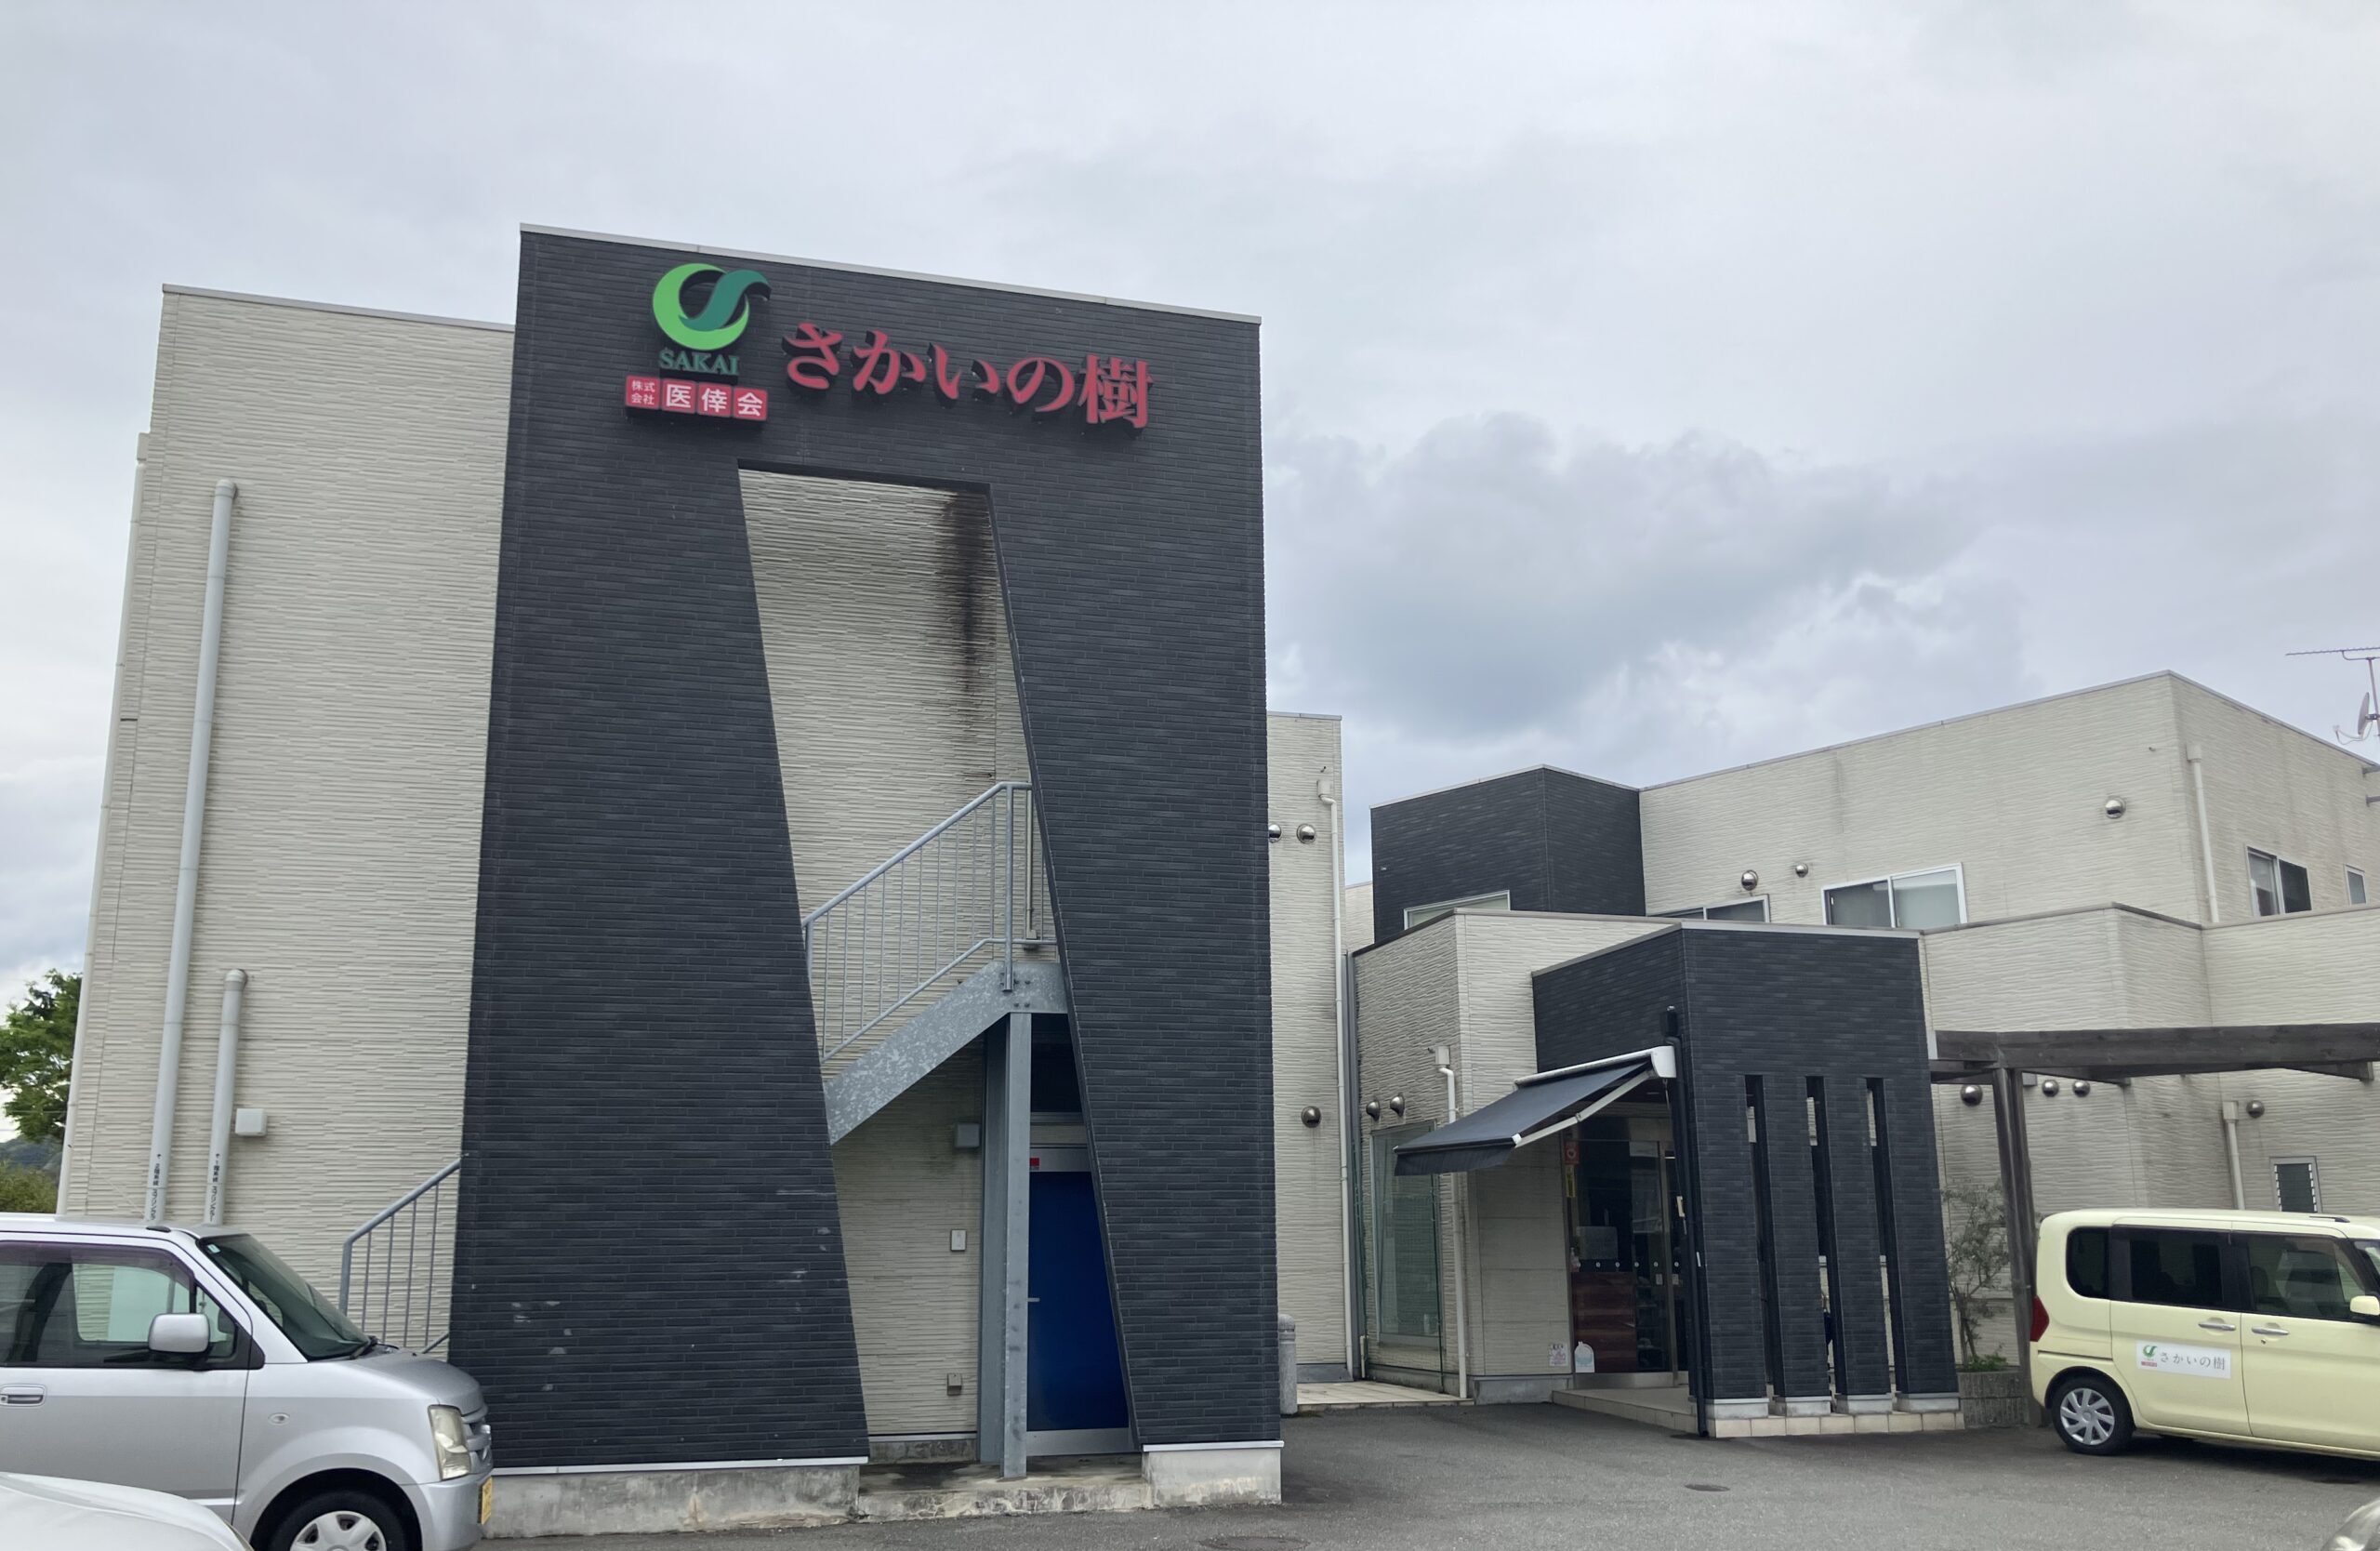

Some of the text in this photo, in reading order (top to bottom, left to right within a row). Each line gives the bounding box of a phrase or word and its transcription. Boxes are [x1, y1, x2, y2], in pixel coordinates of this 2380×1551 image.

[659, 347, 739, 376] SAKAI
[782, 322, 1153, 429] さかいの樹
[631, 379, 655, 392] 株式
[631, 392, 655, 405] 会社
[666, 383, 763, 417] 医倖会
